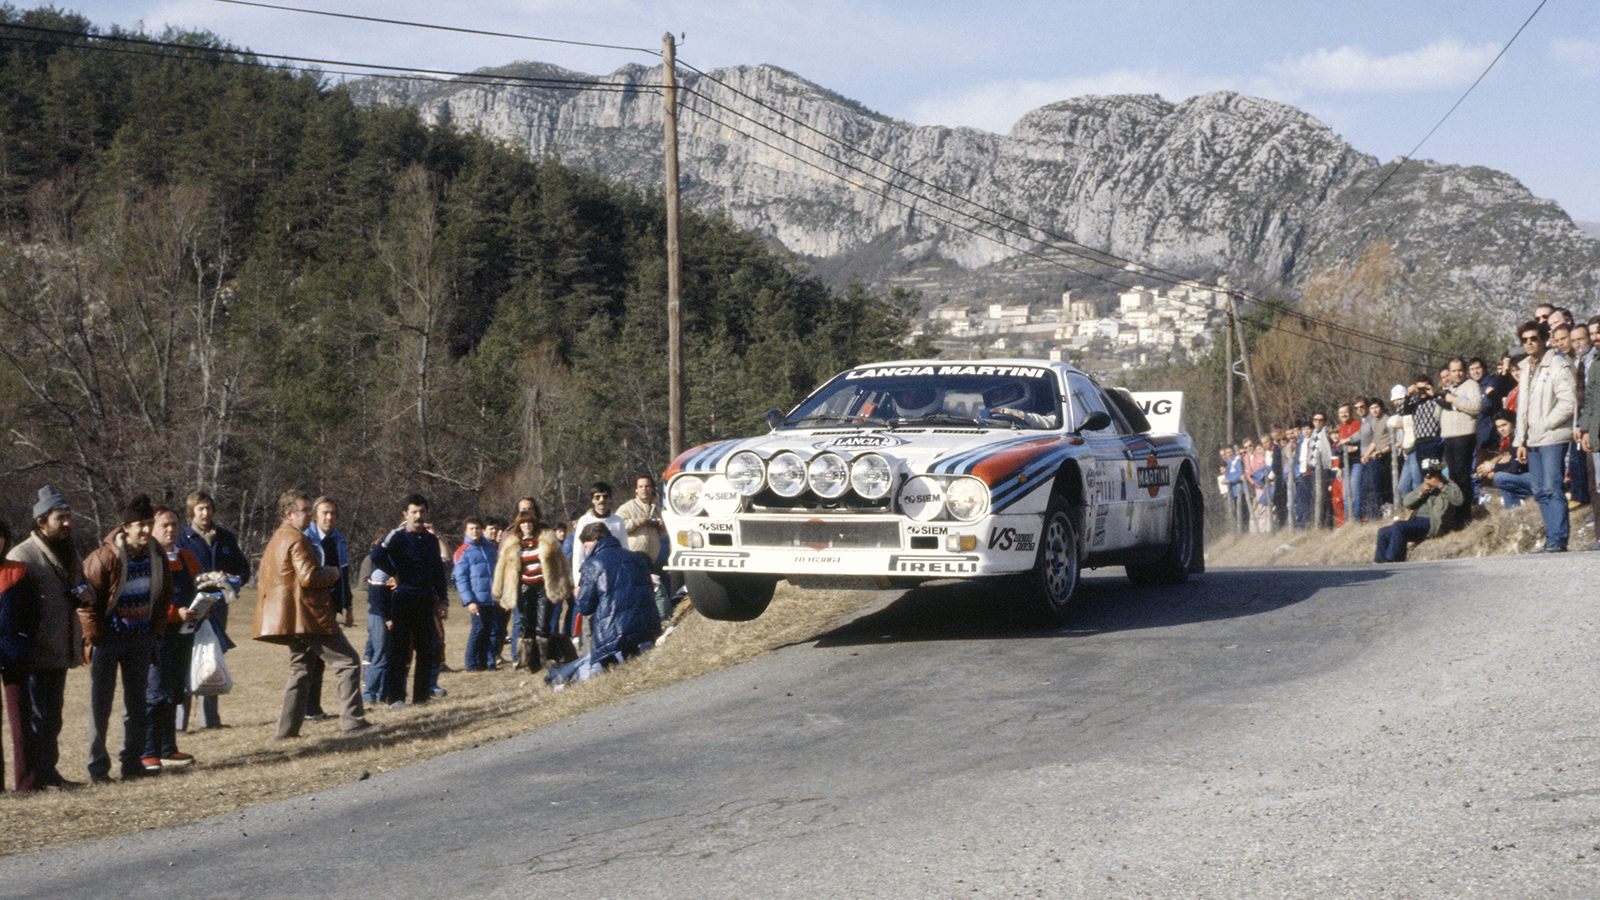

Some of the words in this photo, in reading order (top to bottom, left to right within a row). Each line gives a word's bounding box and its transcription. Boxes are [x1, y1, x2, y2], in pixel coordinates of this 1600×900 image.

[845, 366, 935, 380] LANCIA
[938, 366, 1046, 378] MARTINI
[834, 437, 881, 446] LANCIA
[1138, 468, 1169, 486] MARTINI
[715, 492, 737, 500] SIEM
[916, 494, 941, 503] SIEM
[710, 523, 734, 532] SIEM
[921, 526, 948, 535] SIEM
[988, 526, 1016, 551] VS
[672, 550, 751, 568] PIRELLI
[888, 554, 980, 572] PIRELLI
